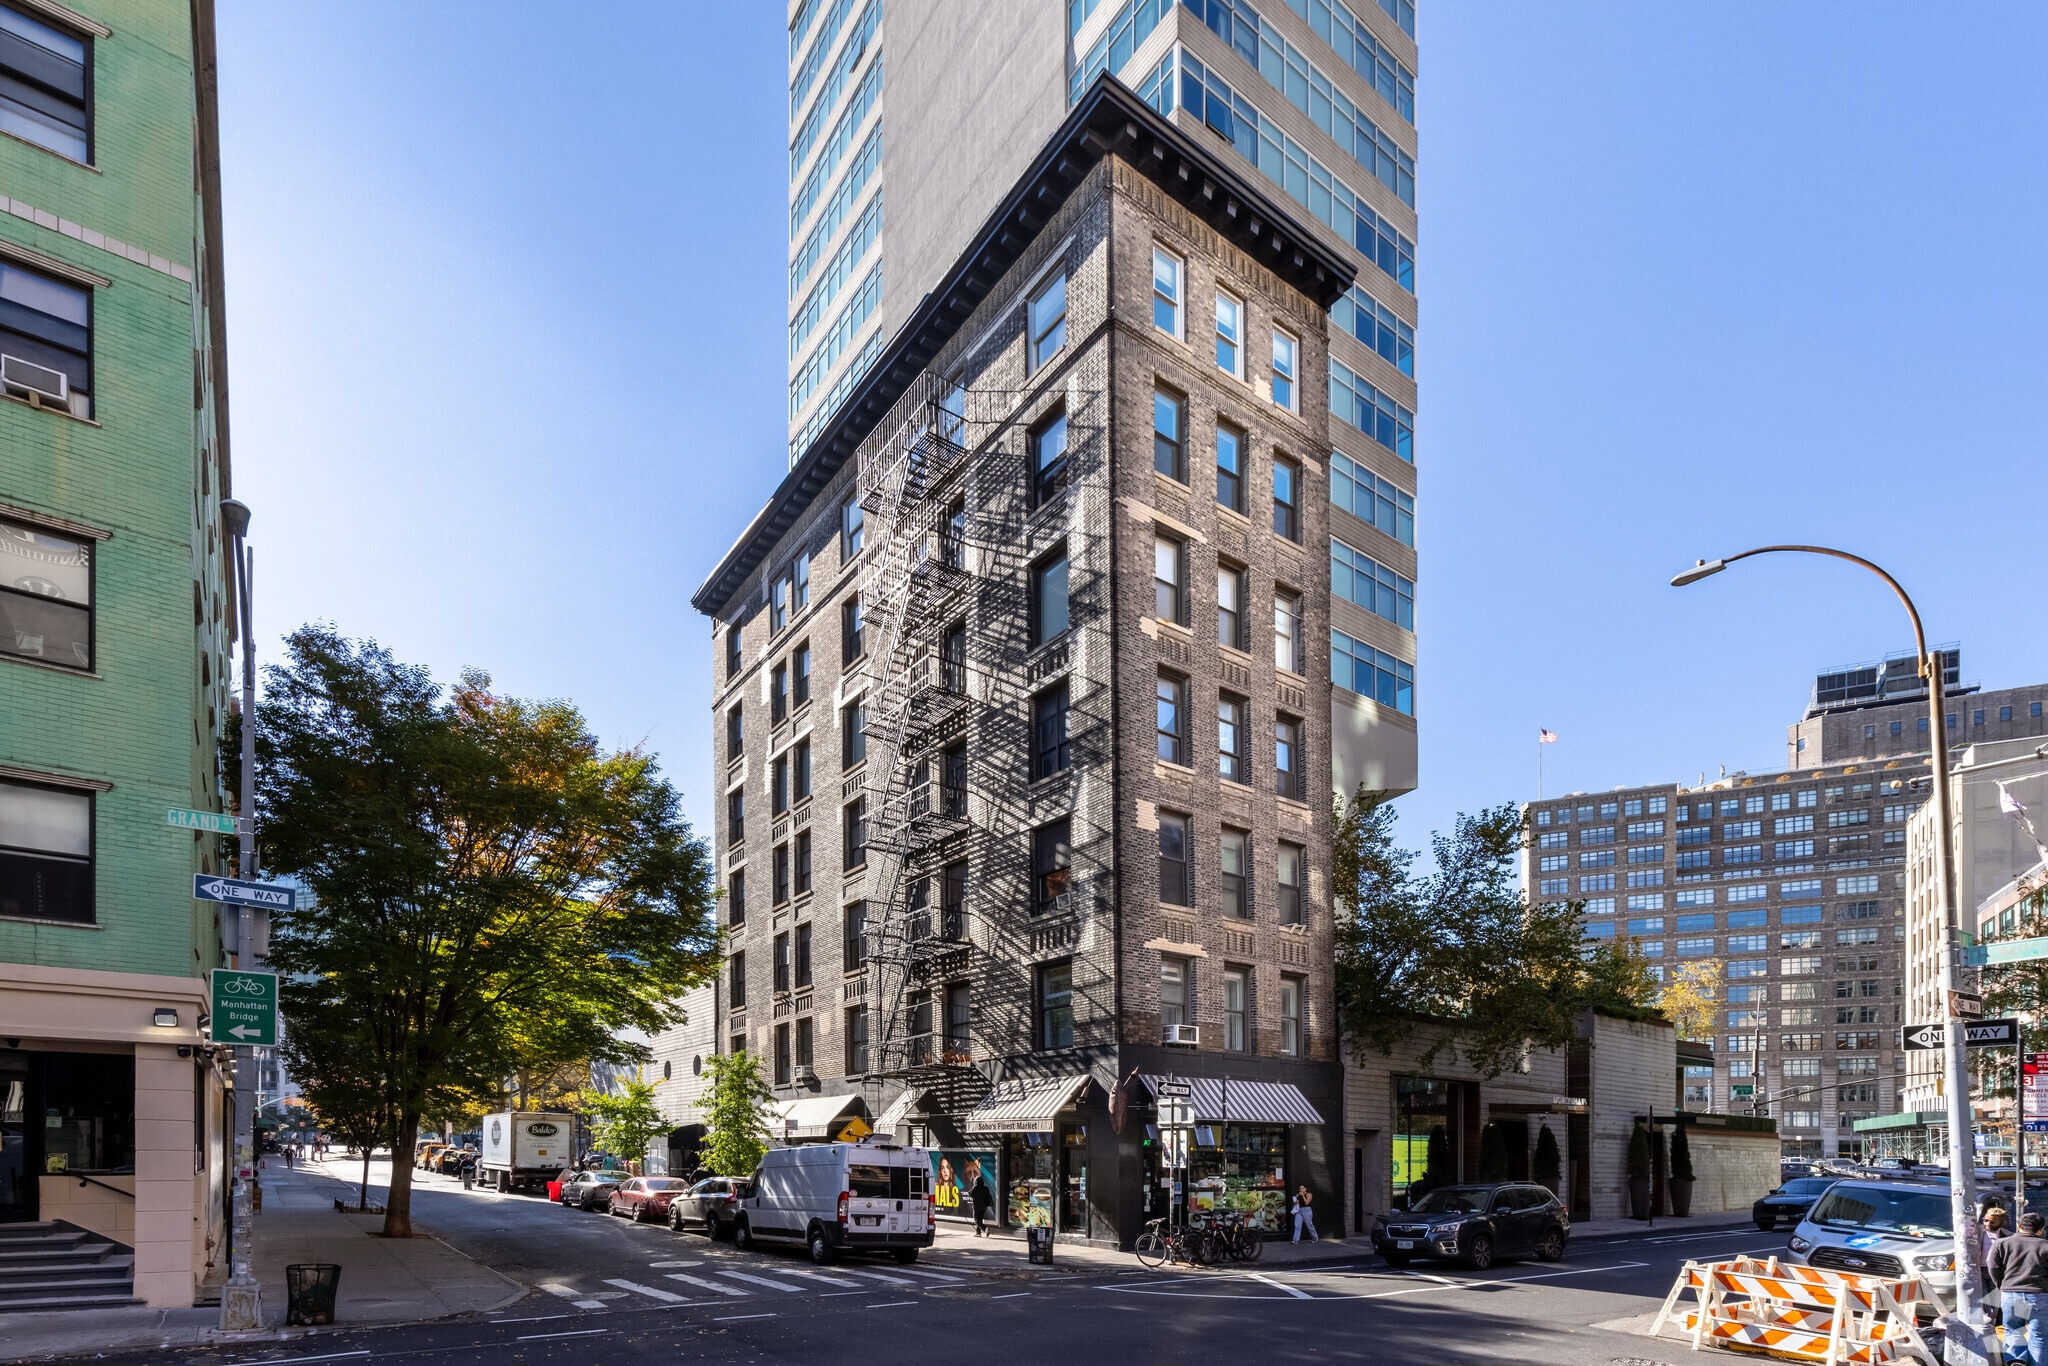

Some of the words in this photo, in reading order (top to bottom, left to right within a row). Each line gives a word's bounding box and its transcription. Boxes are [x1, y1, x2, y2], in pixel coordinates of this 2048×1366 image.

[168, 809, 219, 830] GRAND
[211, 884, 239, 897] ONE
[253, 890, 283, 903] WAY
[221, 1000, 268, 1010] Manhattan
[1955, 999, 1965, 1010] ONE
[1969, 1001, 1980, 1011] WAY
[230, 1012, 259, 1022] Bridge
[1966, 1027, 2002, 1039] WAY
[2023, 1077, 2032, 1086] 3
[531, 1125, 556, 1134] Baldor
[998, 1122, 1015, 1130] Finest
[1017, 1122, 1037, 1130] Market
